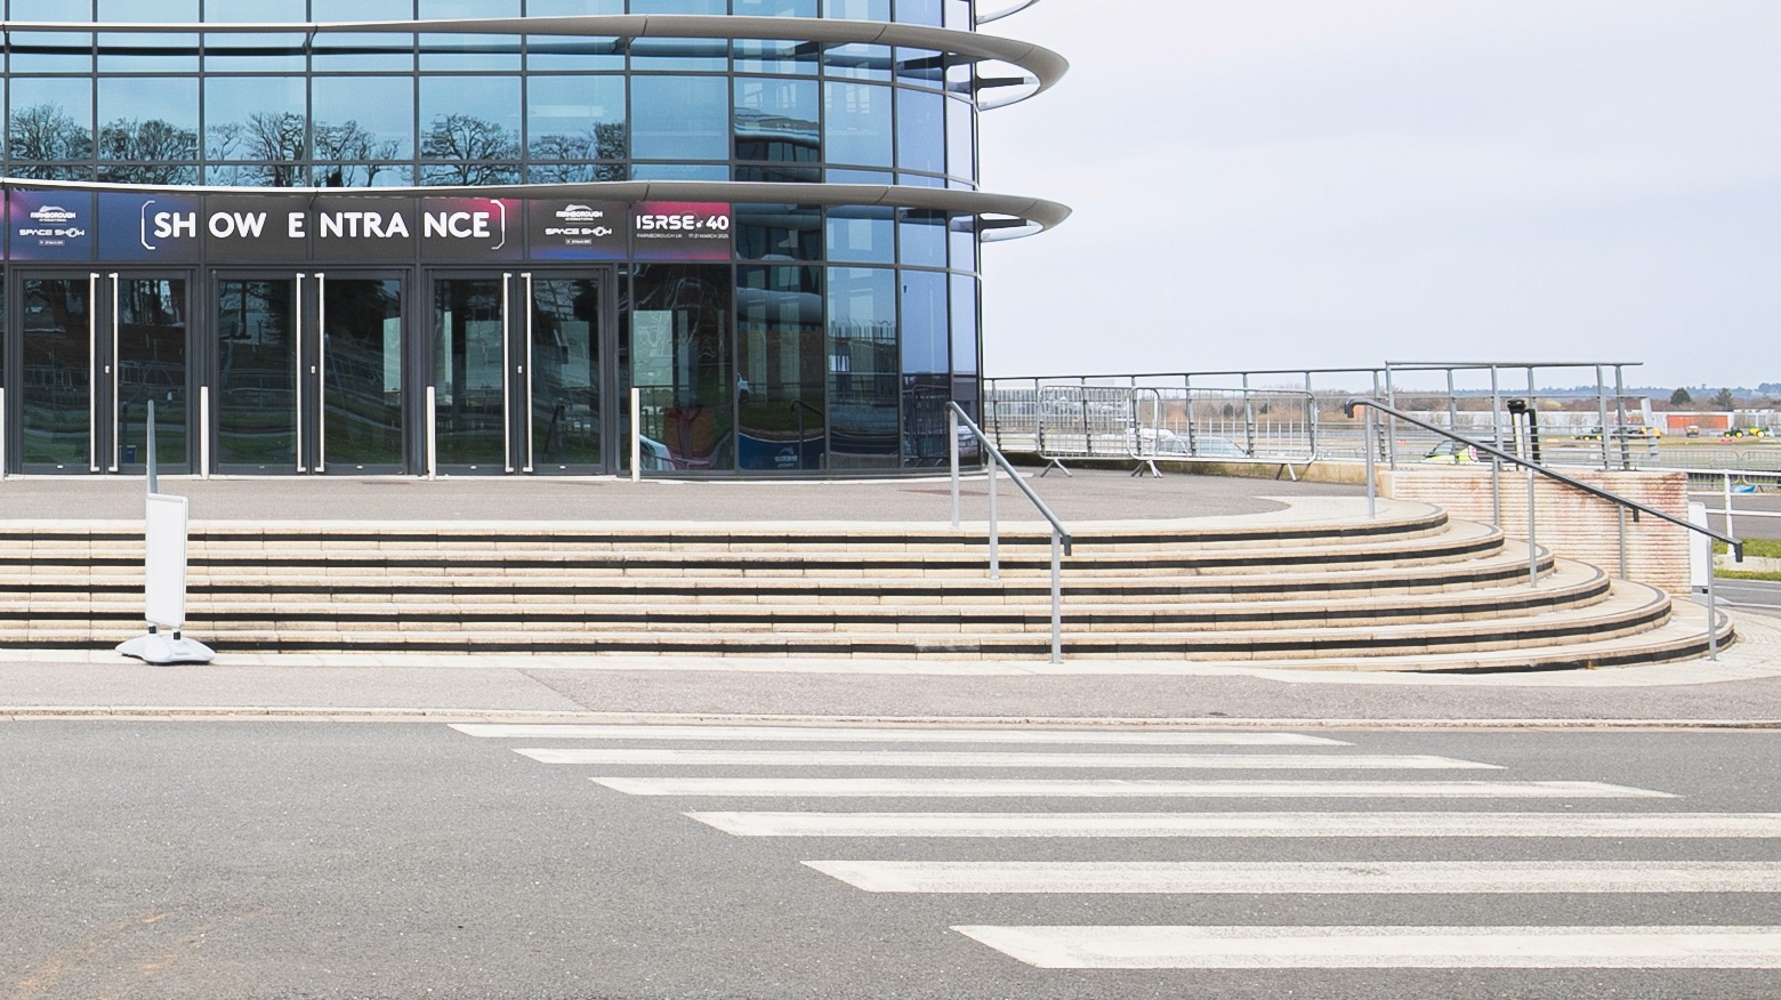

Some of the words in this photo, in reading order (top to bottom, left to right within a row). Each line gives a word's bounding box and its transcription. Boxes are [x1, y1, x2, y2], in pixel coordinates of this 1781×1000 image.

[635, 214, 695, 230] ISRSE
[705, 214, 730, 230] 40
[55, 227, 85, 238] SHOW
[581, 226, 613, 237] SHOW
